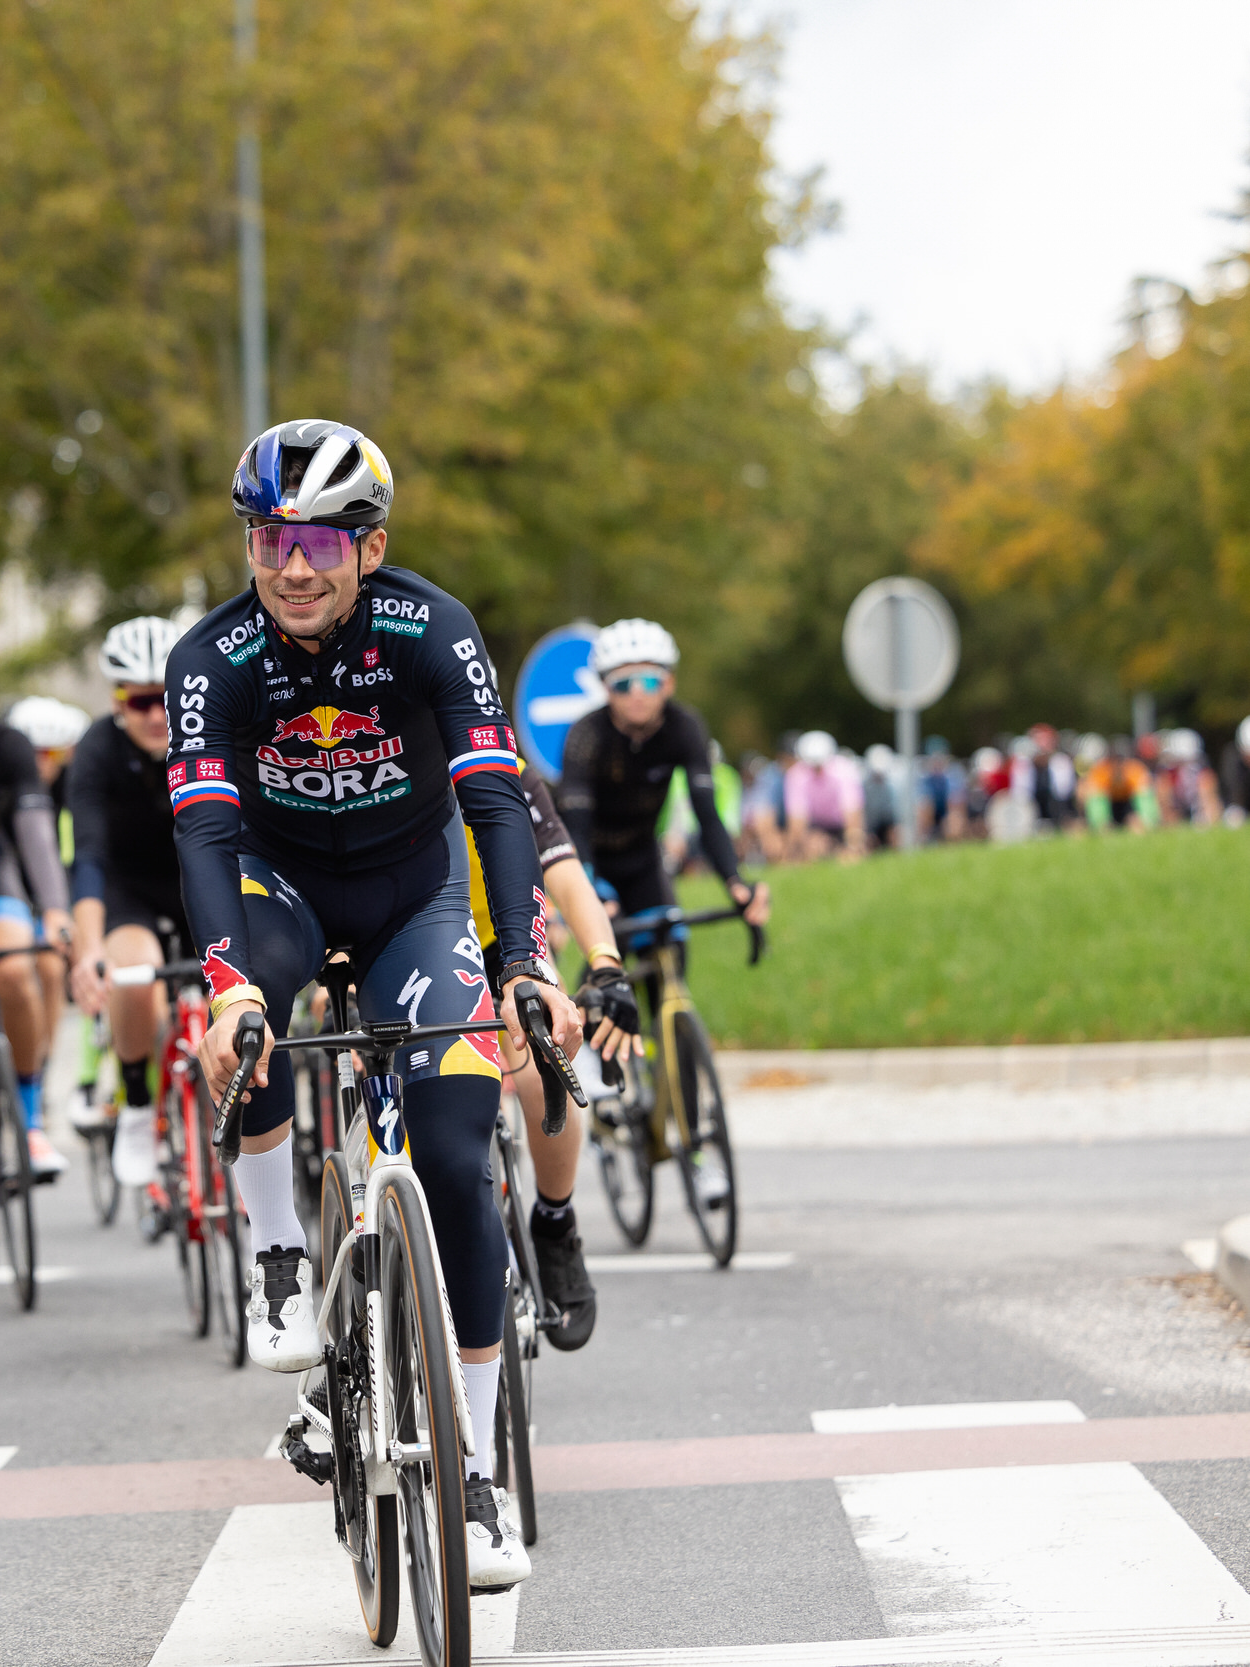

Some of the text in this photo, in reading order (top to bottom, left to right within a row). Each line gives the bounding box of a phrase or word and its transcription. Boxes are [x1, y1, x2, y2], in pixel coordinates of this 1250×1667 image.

[371, 598, 429, 622] BORA
[215, 612, 265, 655] BORA
[371, 620, 423, 635] hansgrohe
[352, 667, 394, 687] BOSS
[180, 674, 209, 753] BOSS
[473, 729, 495, 738] ÖTZ
[475, 738, 497, 746] TAL
[200, 760, 221, 769] ÖTZ
[256, 736, 403, 772] Red Bull
[258, 761, 409, 801] BORA
[543, 1034, 580, 1089] SRAM
[216, 1069, 244, 1129] SRAM
